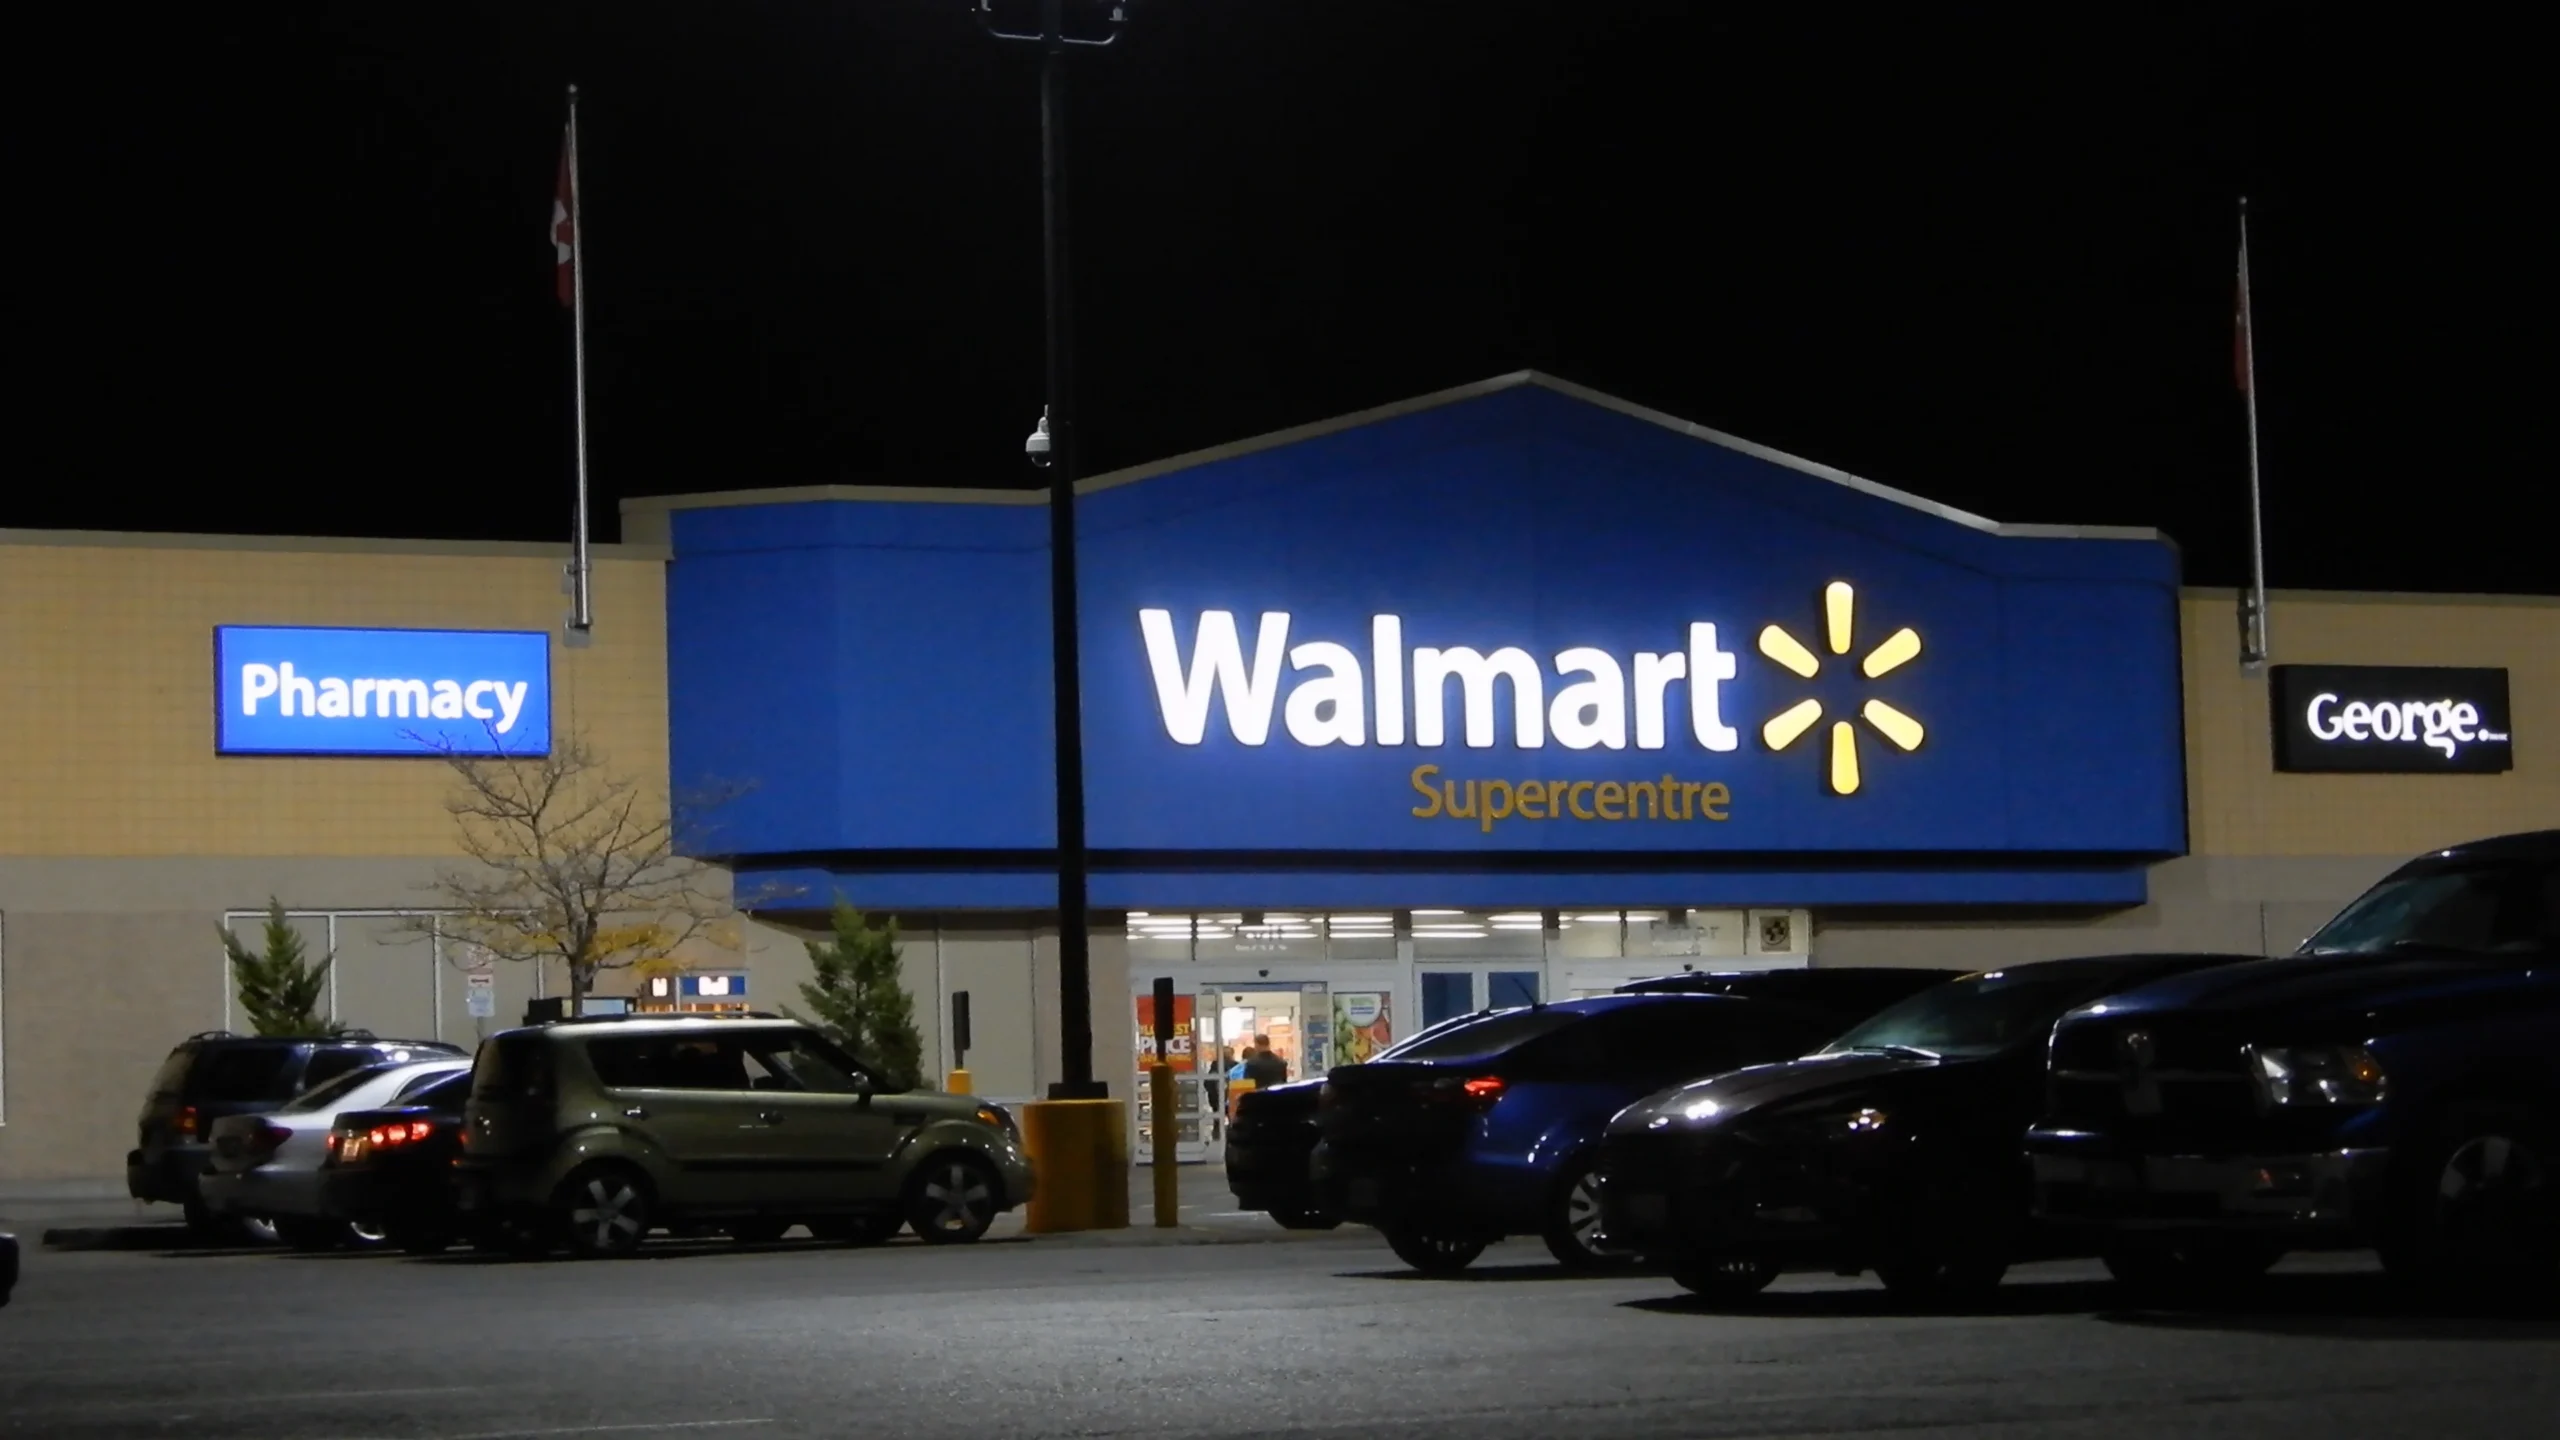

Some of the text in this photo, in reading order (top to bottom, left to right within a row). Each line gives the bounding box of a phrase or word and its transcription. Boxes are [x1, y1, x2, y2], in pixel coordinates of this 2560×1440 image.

[242, 661, 528, 734] Pharmacy
[1139, 607, 1739, 753] Walmart
[1411, 764, 1731, 833] Supercentre
